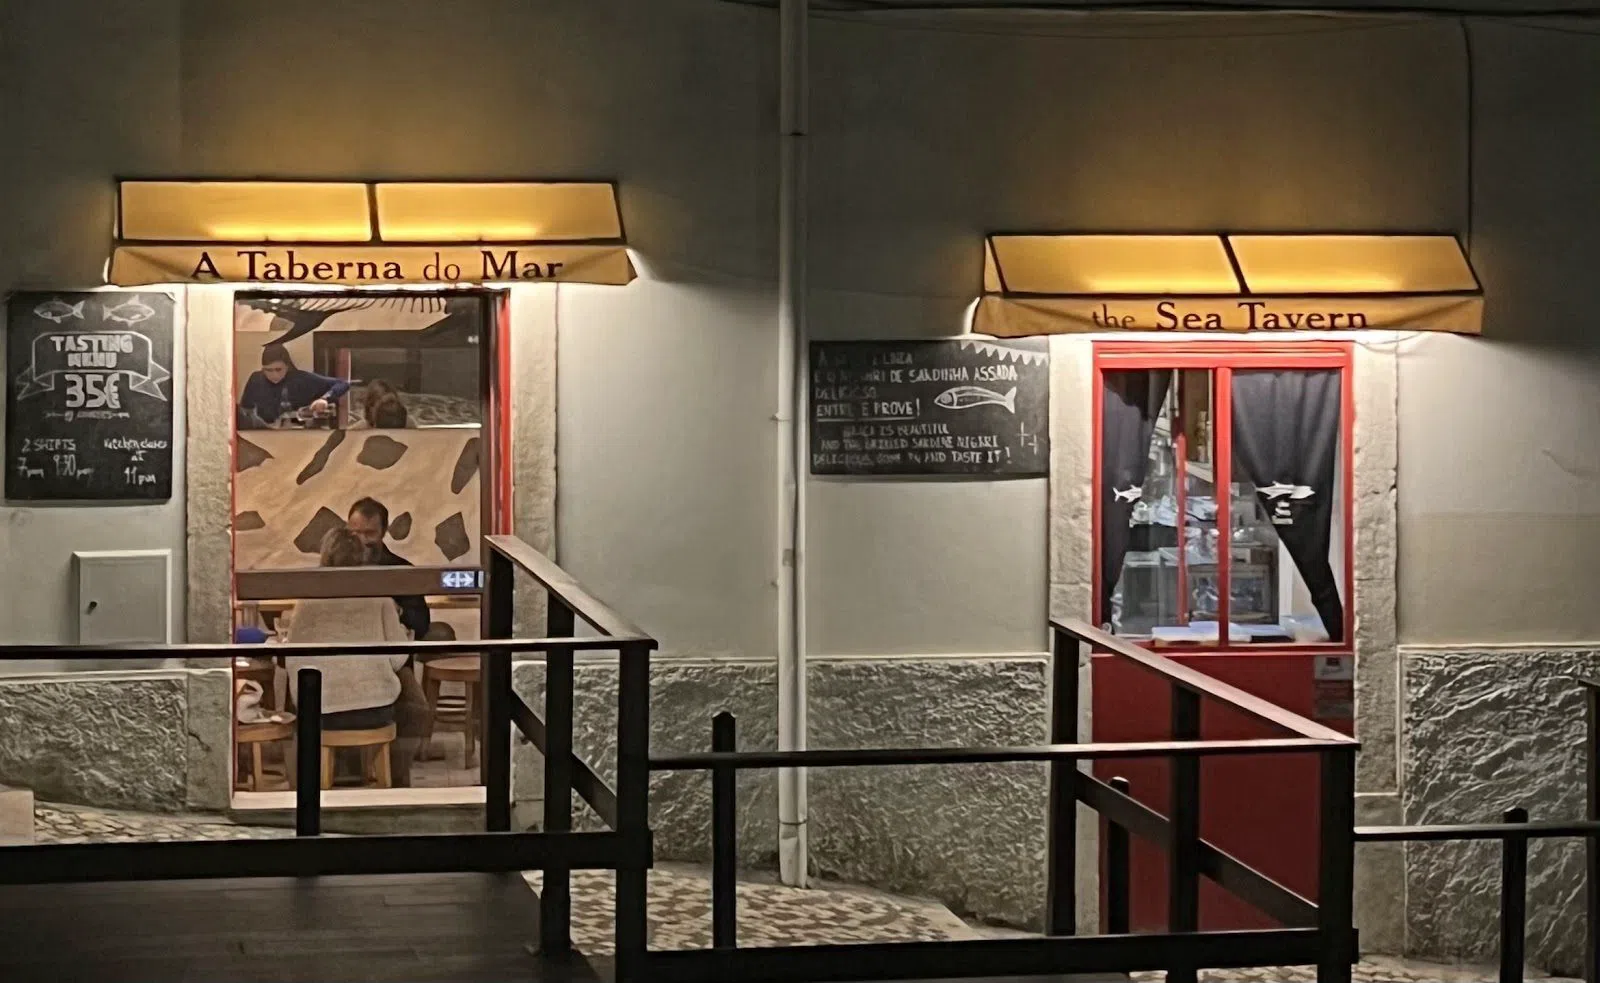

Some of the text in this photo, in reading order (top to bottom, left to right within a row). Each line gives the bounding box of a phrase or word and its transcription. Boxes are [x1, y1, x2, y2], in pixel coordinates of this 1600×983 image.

[190, 250, 563, 281] A Taberna do Mar
[1093, 302, 1368, 330] the Sea Tavern
[50, 334, 133, 353] TASTING
[68, 352, 117, 367] MENU
[890, 369, 903, 384] DE
[974, 364, 1018, 382] ASSADA
[65, 372, 120, 408] 35€
[21, 438, 31, 453] 2
